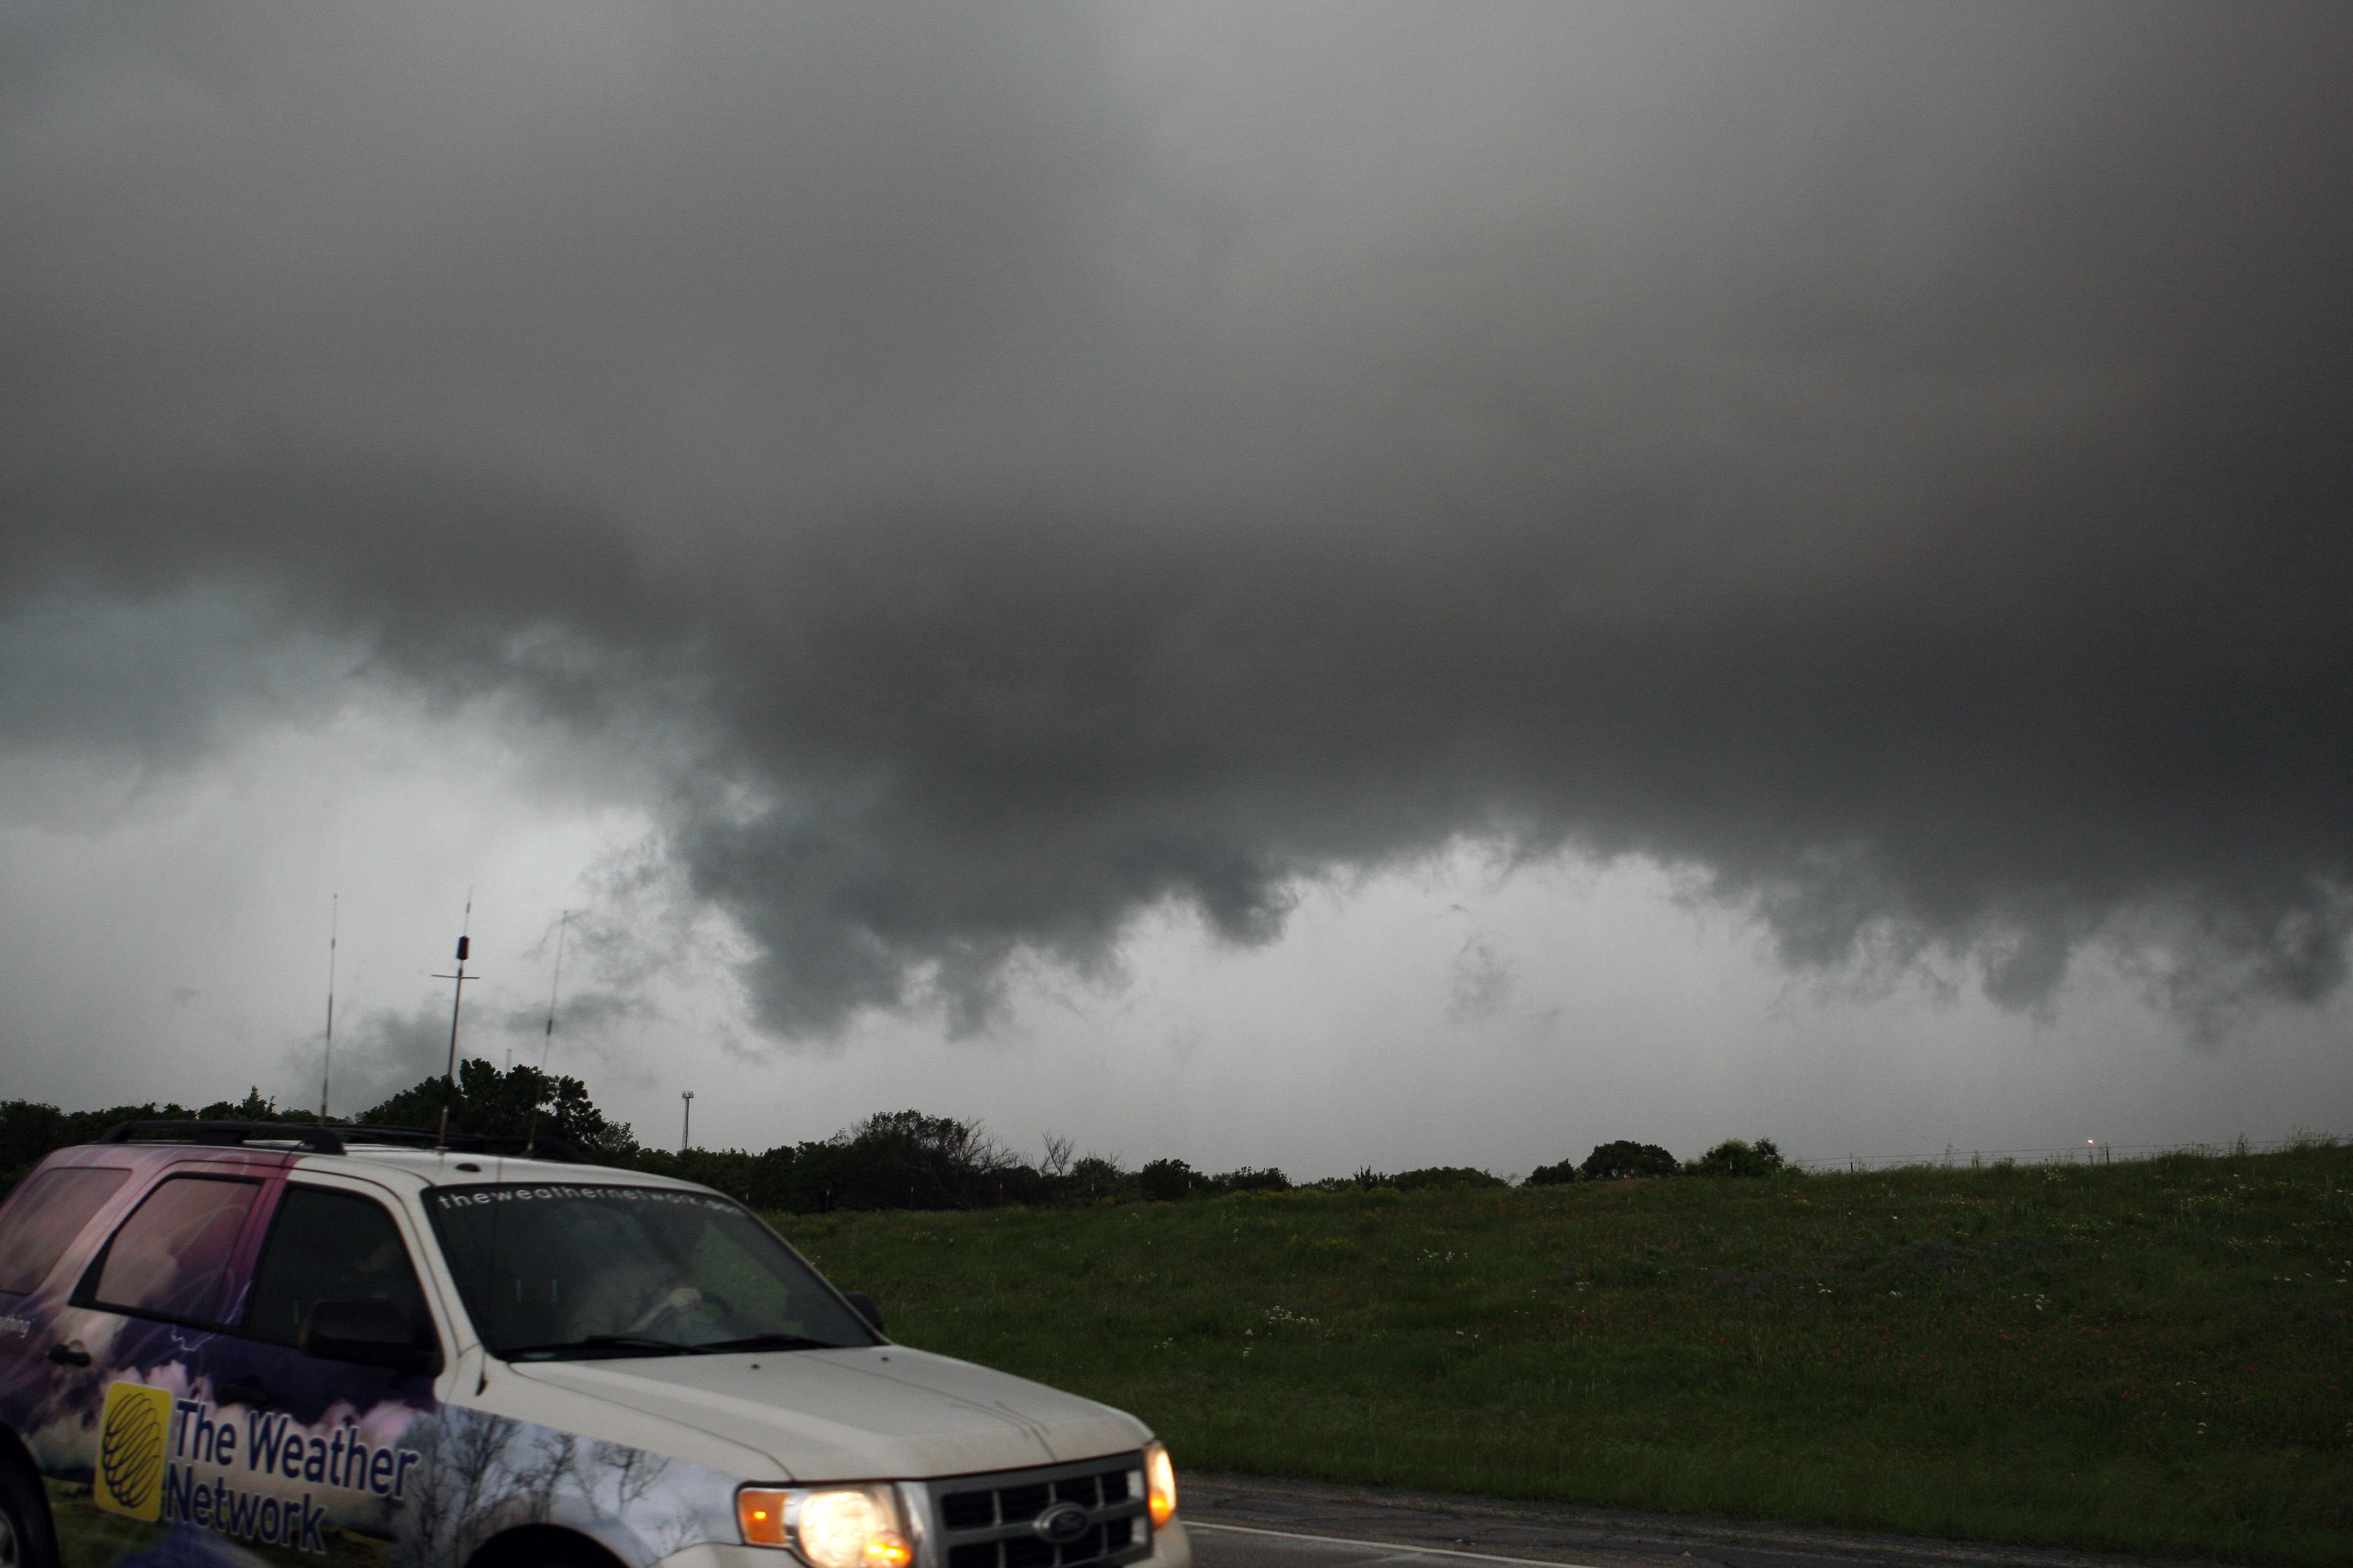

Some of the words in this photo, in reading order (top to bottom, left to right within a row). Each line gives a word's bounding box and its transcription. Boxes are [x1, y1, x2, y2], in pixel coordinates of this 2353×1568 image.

[438, 1186, 746, 1216] theweathernetwork.
[177, 1399, 235, 1465] The
[249, 1412, 418, 1497] Weather
[167, 1462, 326, 1552] Network
